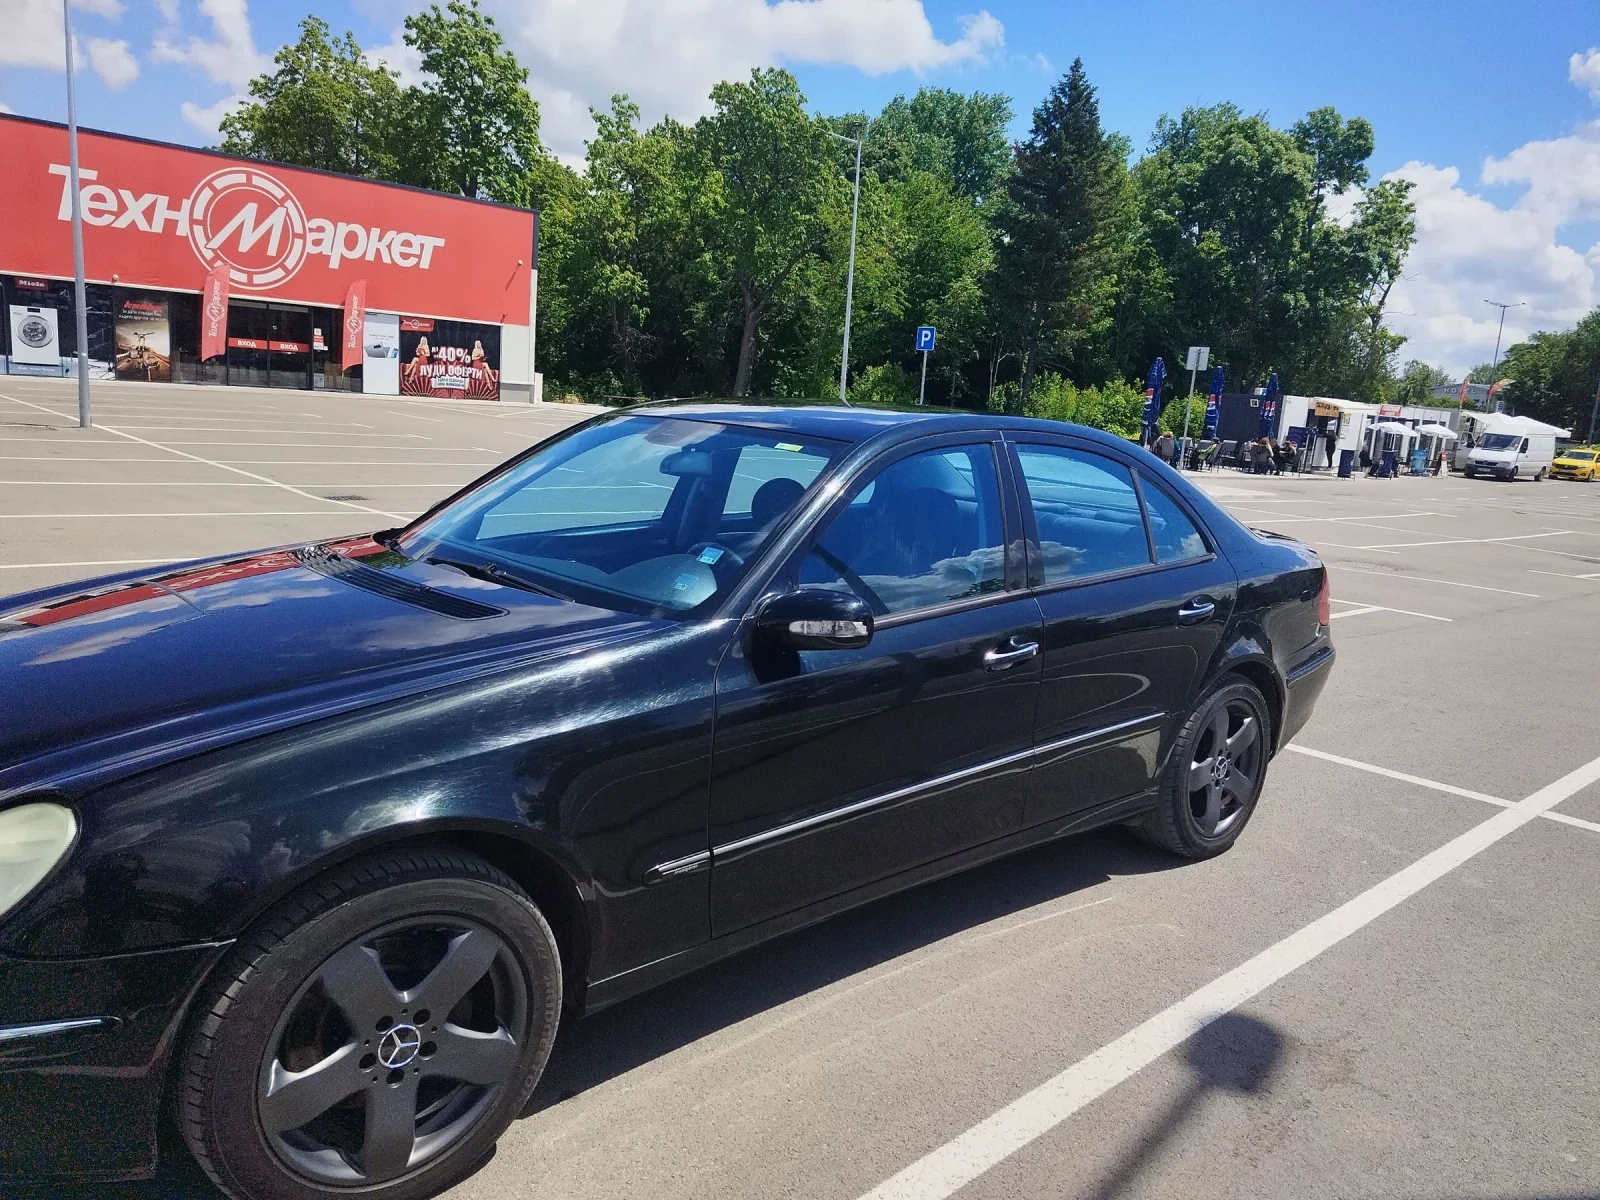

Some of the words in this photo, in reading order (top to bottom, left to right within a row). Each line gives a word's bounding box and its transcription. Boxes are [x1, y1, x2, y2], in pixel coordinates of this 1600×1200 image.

[18, 280, 45, 288] Miele
[921, 330, 932, 347] P
[237, 340, 257, 348] ВХОД
[280, 343, 299, 351] ВХОД
[420, 364, 446, 378] ЛУДИ
[448, 364, 483, 380] ОФЕРТИ
